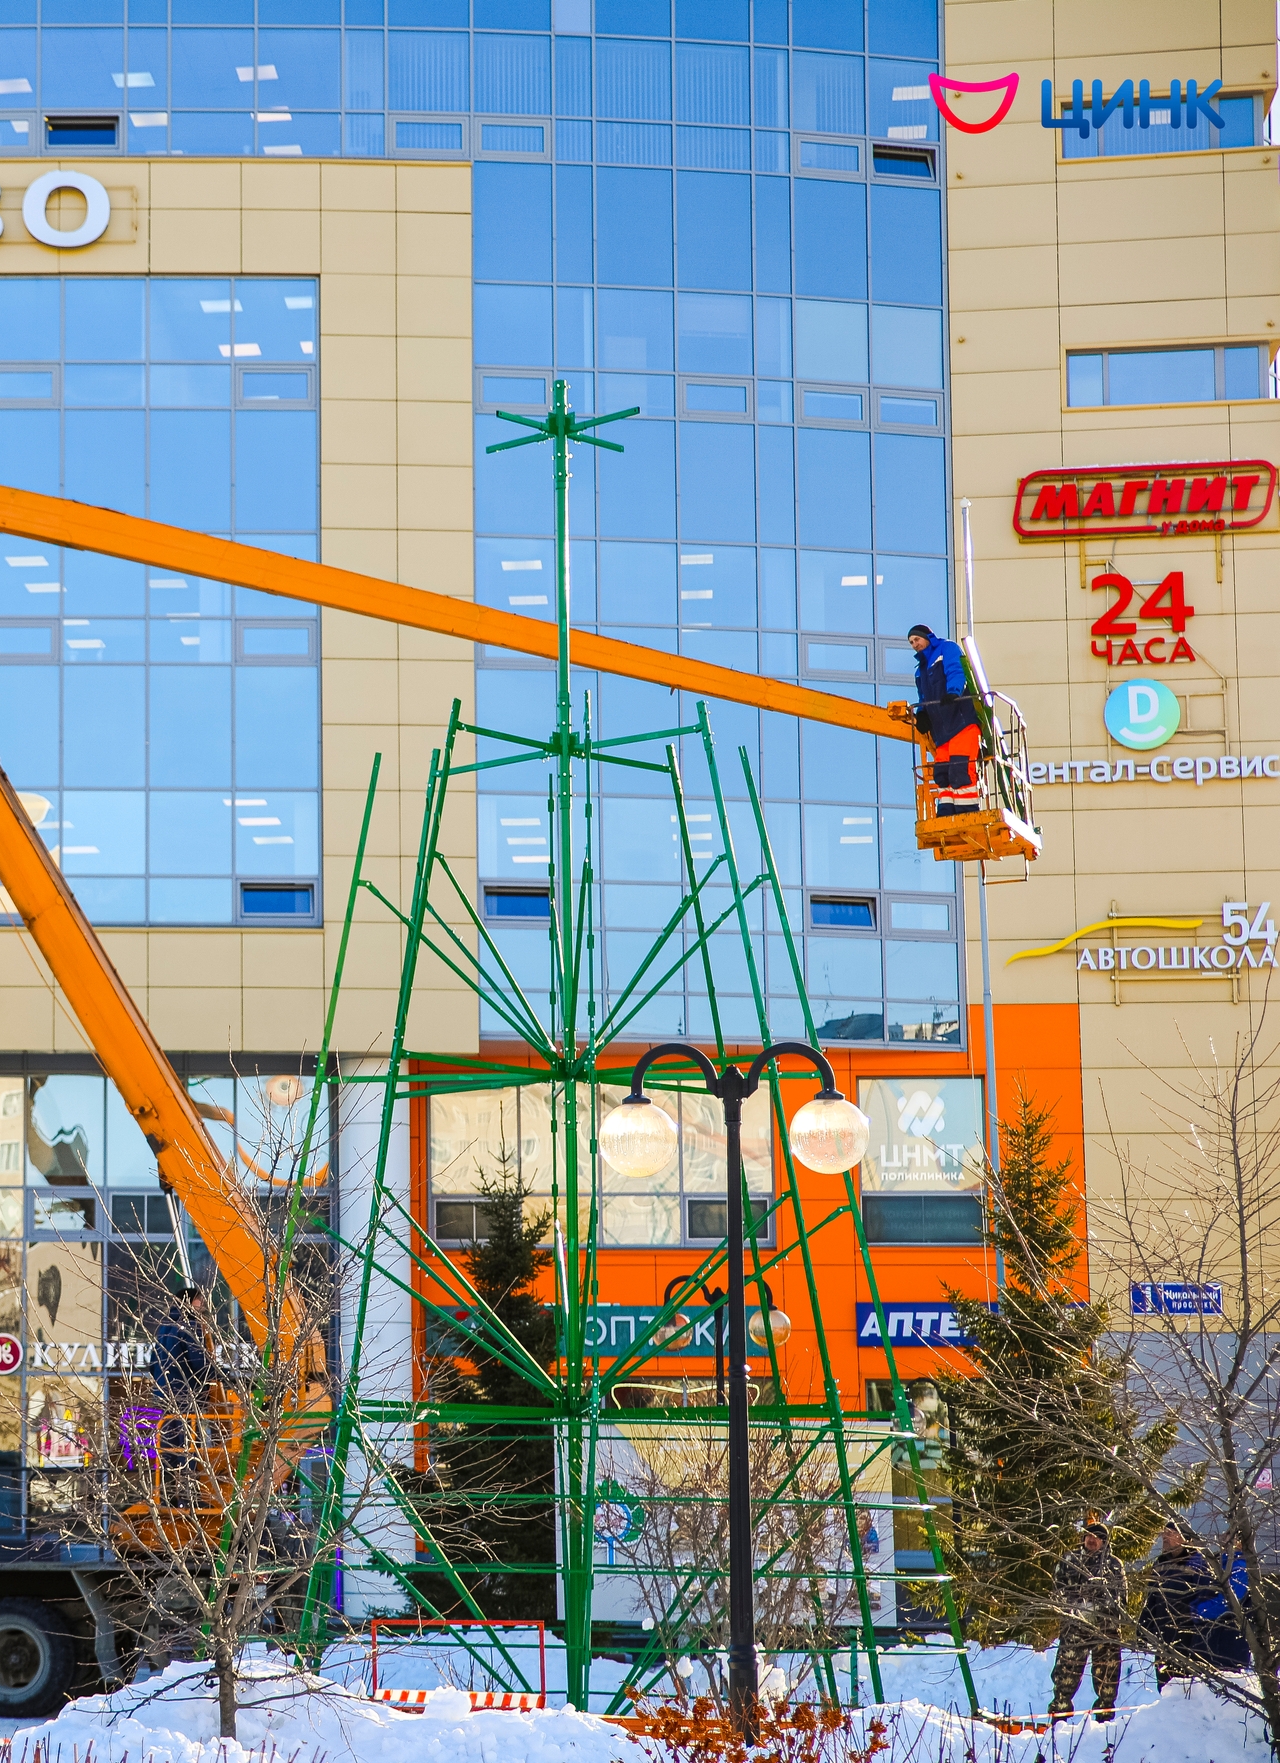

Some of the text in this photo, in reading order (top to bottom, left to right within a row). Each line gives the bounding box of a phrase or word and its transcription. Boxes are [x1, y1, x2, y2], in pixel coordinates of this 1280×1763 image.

[1030, 475, 1260, 520] МАГНИТ
[1161, 519, 1225, 537] у дома
[1090, 571, 1195, 636] 24
[1091, 637, 1196, 666] ЧАСА
[1014, 754, 1280, 786] ентал-Сервис
[1222, 901, 1279, 947] 54
[1076, 945, 1279, 971] АВТОШКОЛА
[880, 1143, 964, 1168] ЦНМТ
[881, 1171, 965, 1181] ПОЛИКЛИНИКА
[581, 1315, 732, 1347] ОПТК
[860, 1311, 974, 1338] АПТЕ
